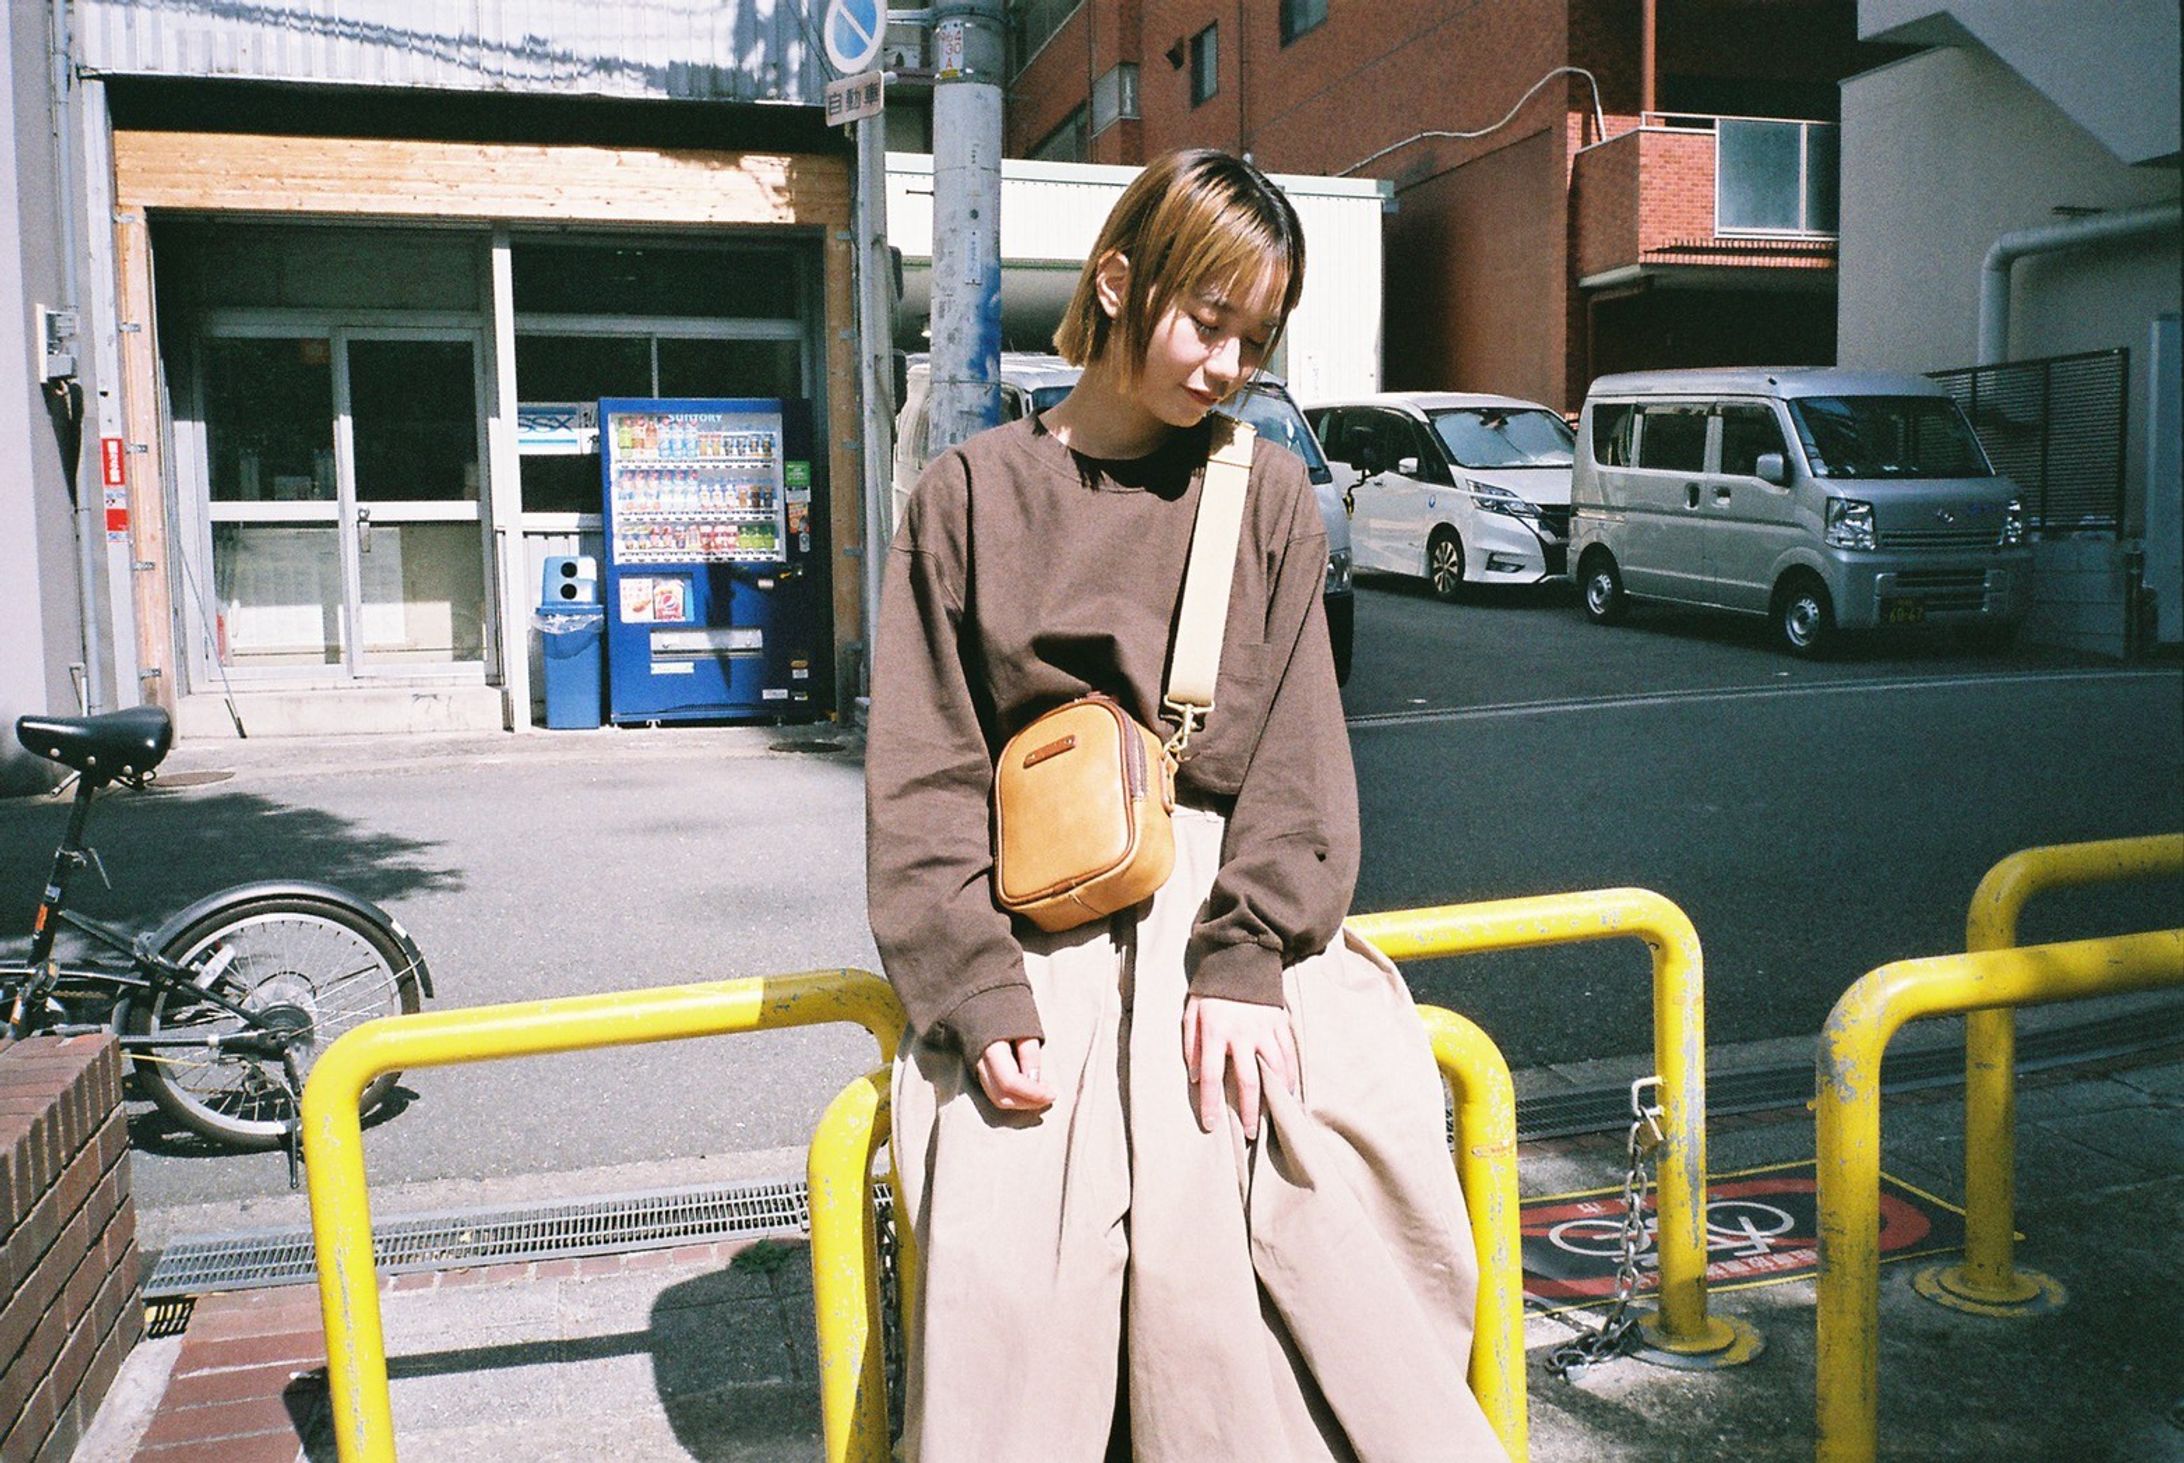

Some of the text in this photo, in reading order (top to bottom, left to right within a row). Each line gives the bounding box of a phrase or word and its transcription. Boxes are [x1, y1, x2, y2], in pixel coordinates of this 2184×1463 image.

[828, 82, 880, 116] 自動車
[668, 413, 722, 423] SUNTORY
